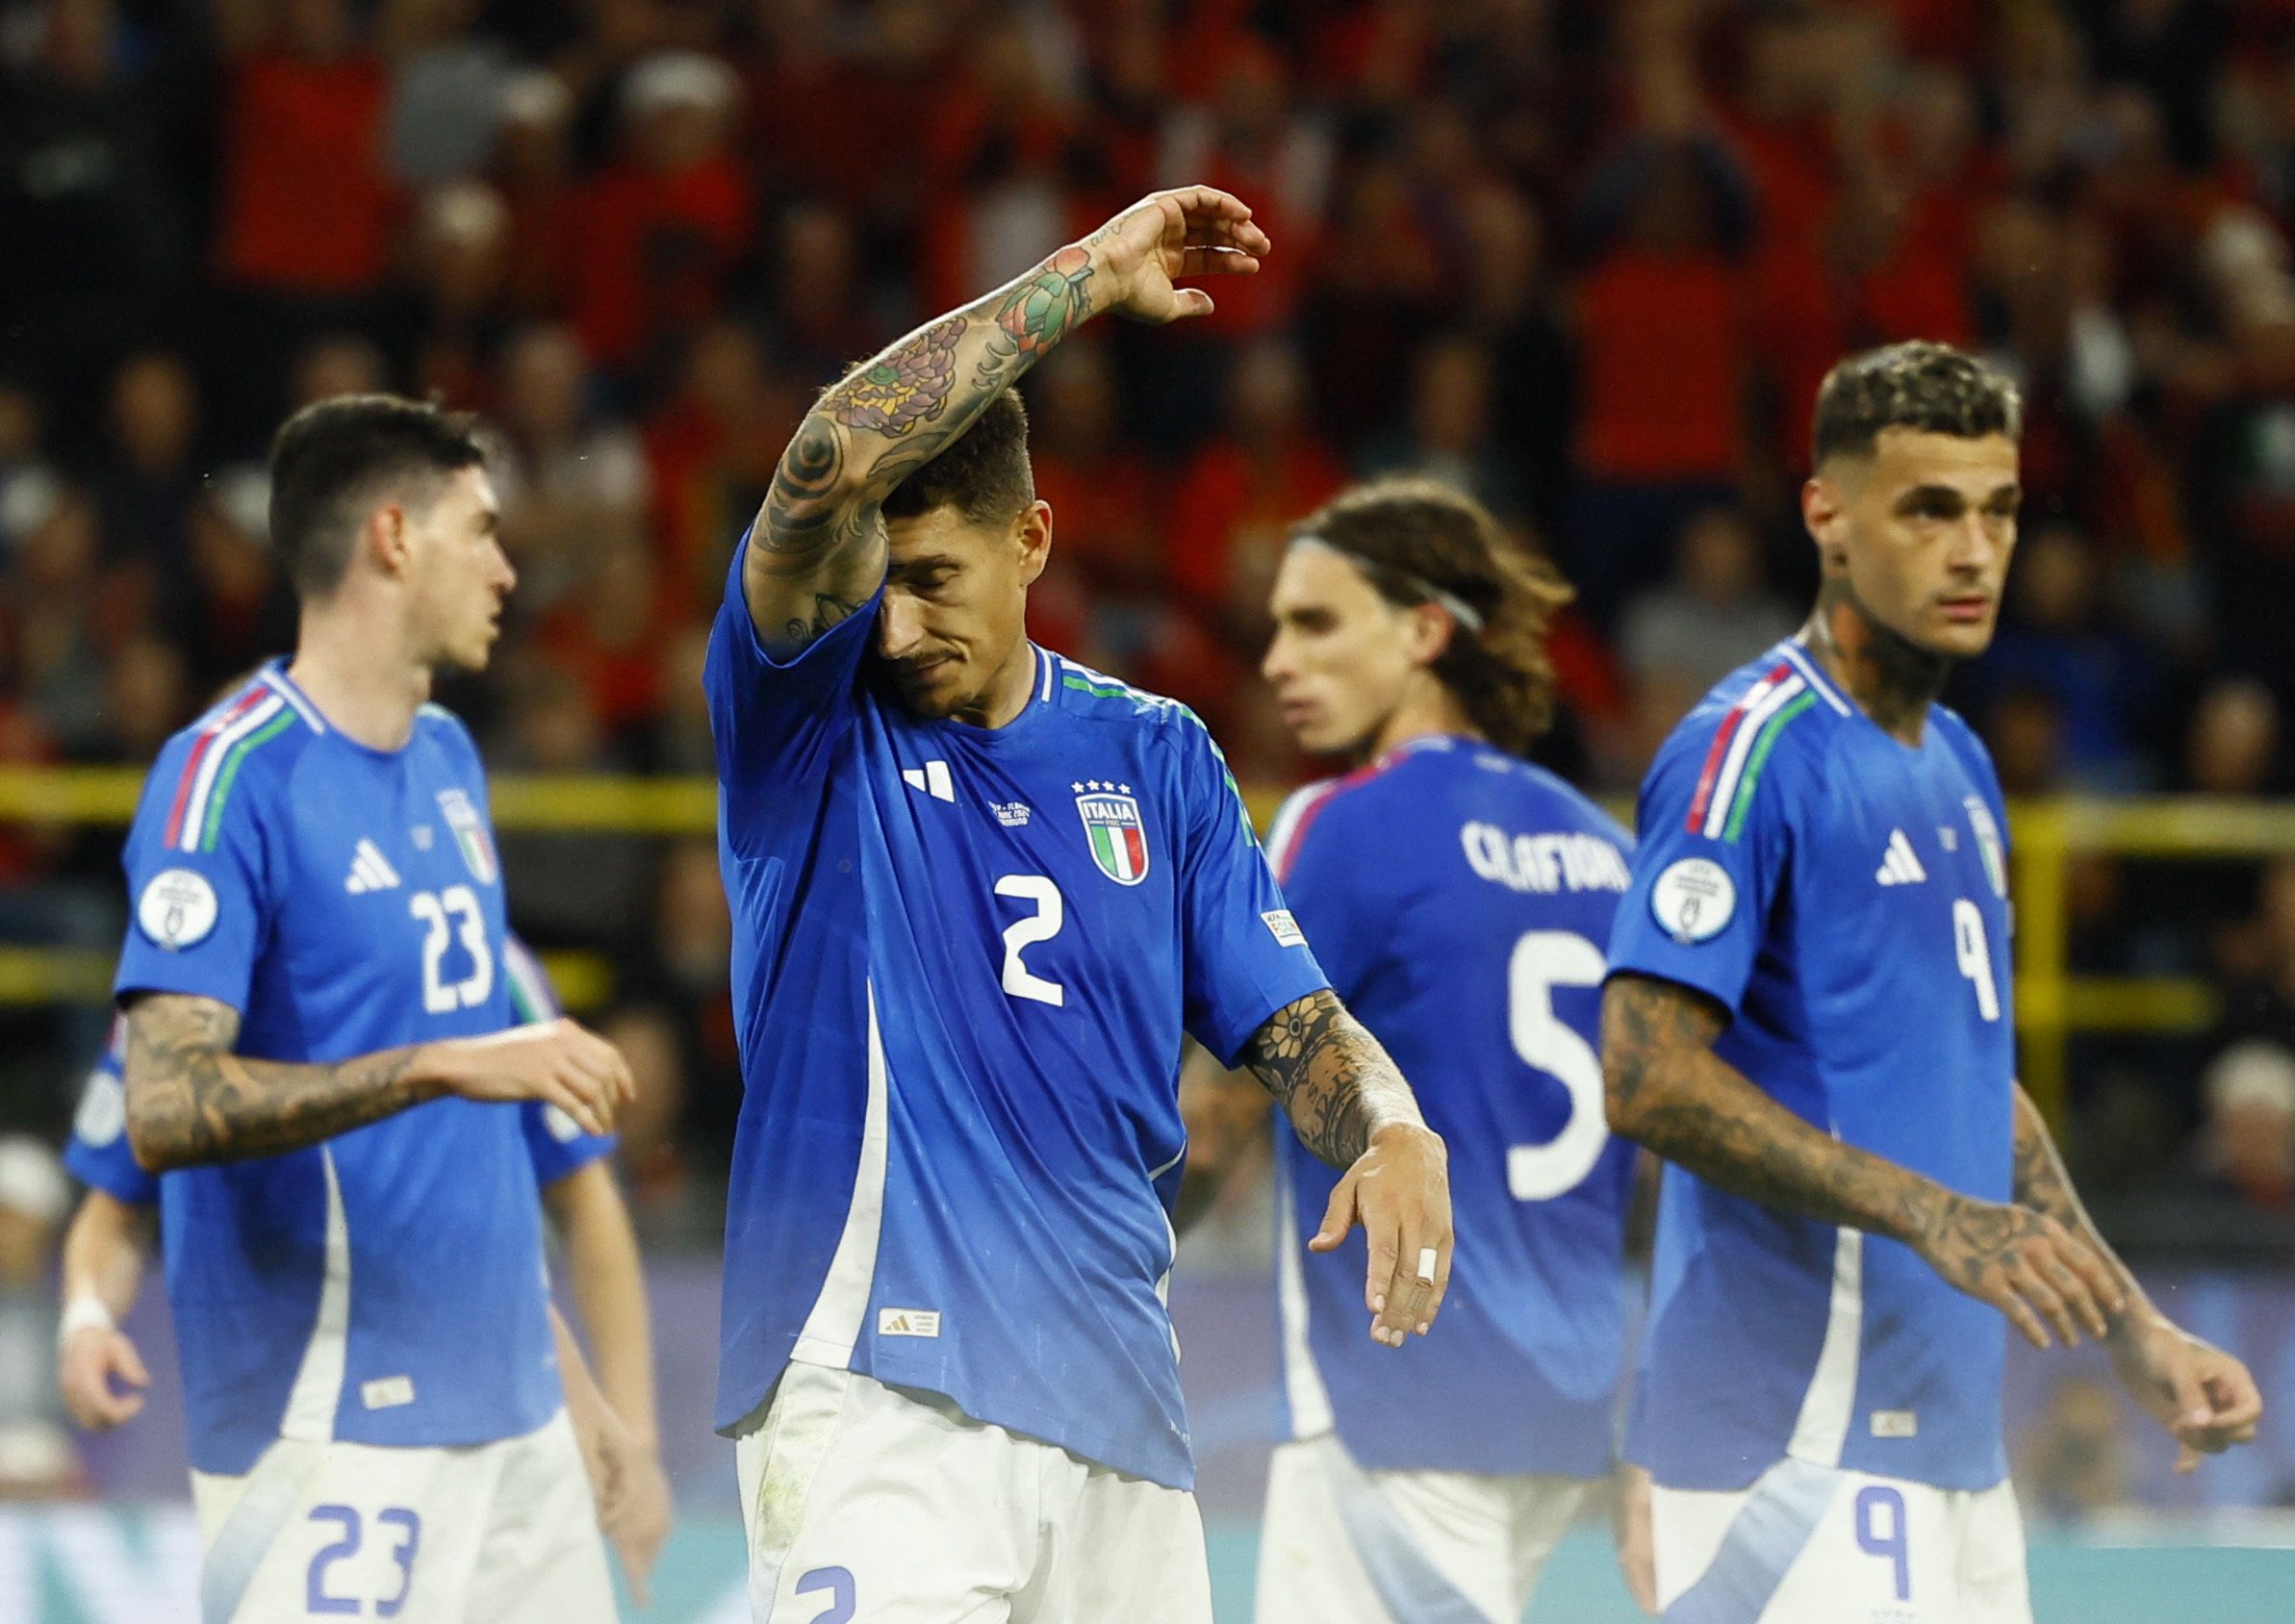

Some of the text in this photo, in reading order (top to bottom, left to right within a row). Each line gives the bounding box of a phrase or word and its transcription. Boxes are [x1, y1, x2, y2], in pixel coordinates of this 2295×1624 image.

[1083, 801, 1135, 821] ITALIA
[409, 883, 495, 1014] 23
[995, 875, 1063, 1007] 2
[1953, 899, 2001, 1022] 9
[1507, 930, 1610, 1202] 5
[307, 1505, 421, 1616] 23
[1854, 1484, 1910, 1601] 9
